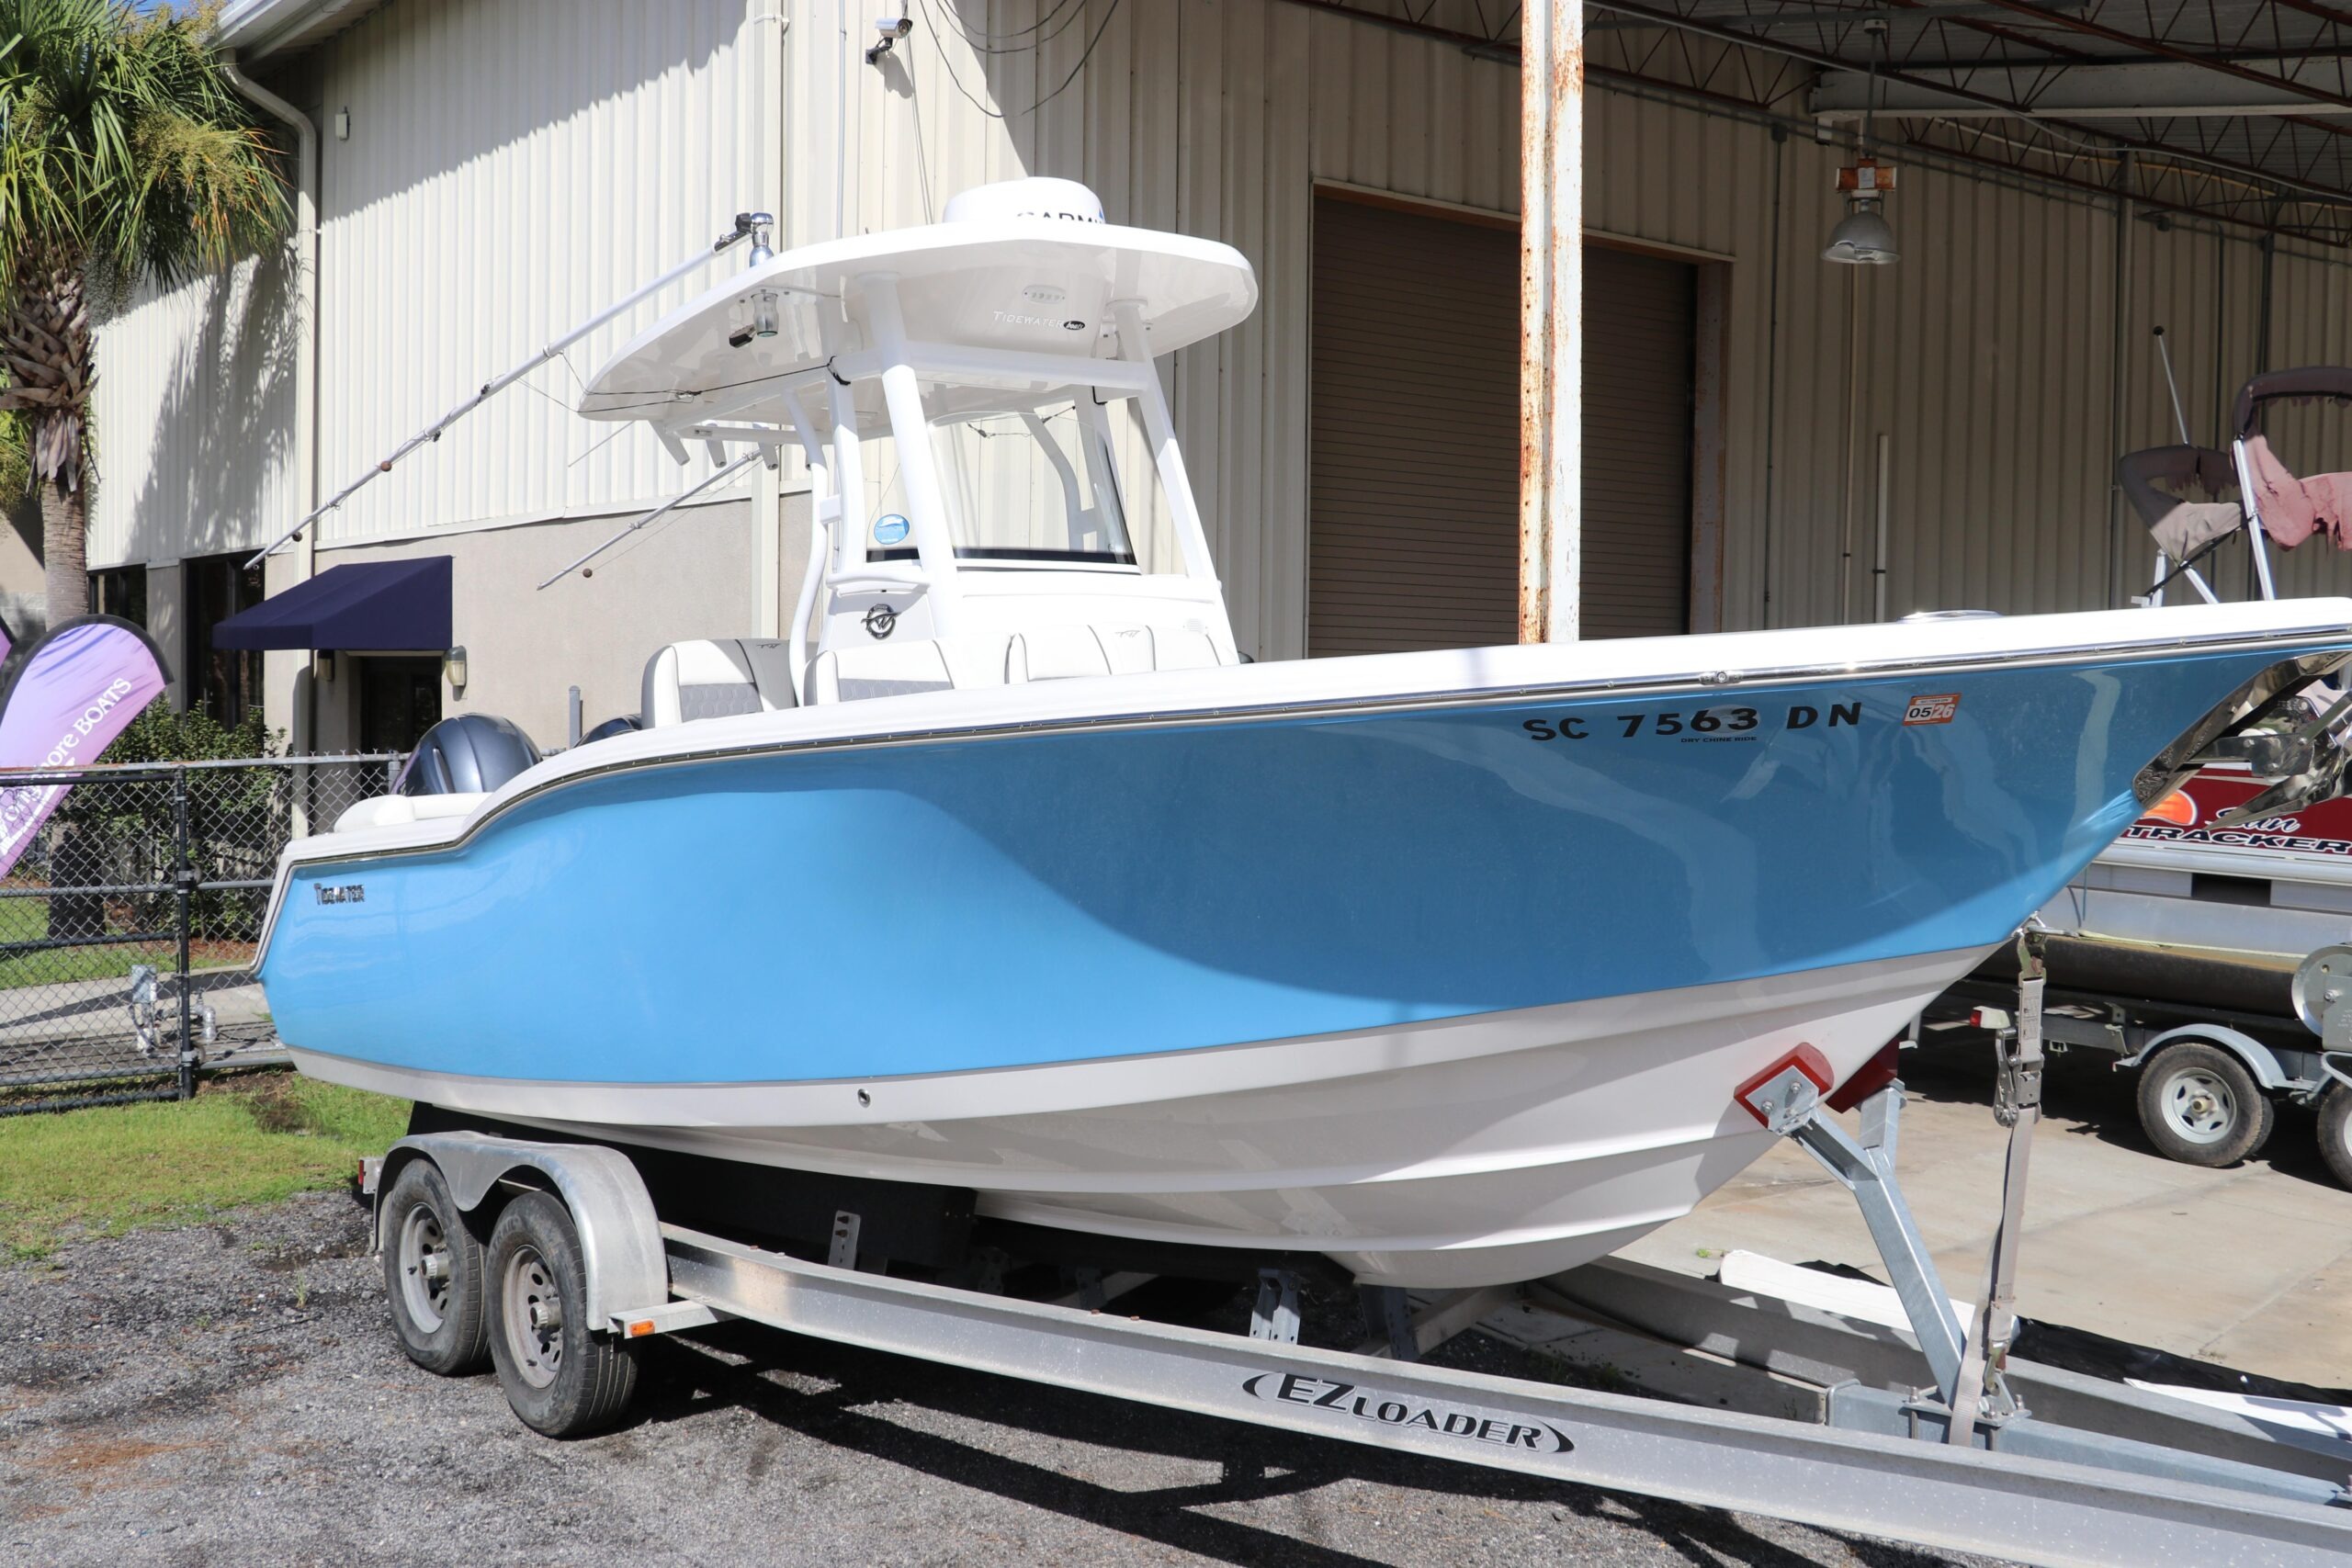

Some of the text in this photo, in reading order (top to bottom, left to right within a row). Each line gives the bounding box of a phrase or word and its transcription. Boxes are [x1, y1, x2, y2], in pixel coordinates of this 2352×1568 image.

[993, 310, 1064, 328] TIDEWATER
[73, 678, 131, 736] BOATS
[1522, 702, 1862, 740] SC 7563 DN
[2126, 825, 2352, 853] TRACKER
